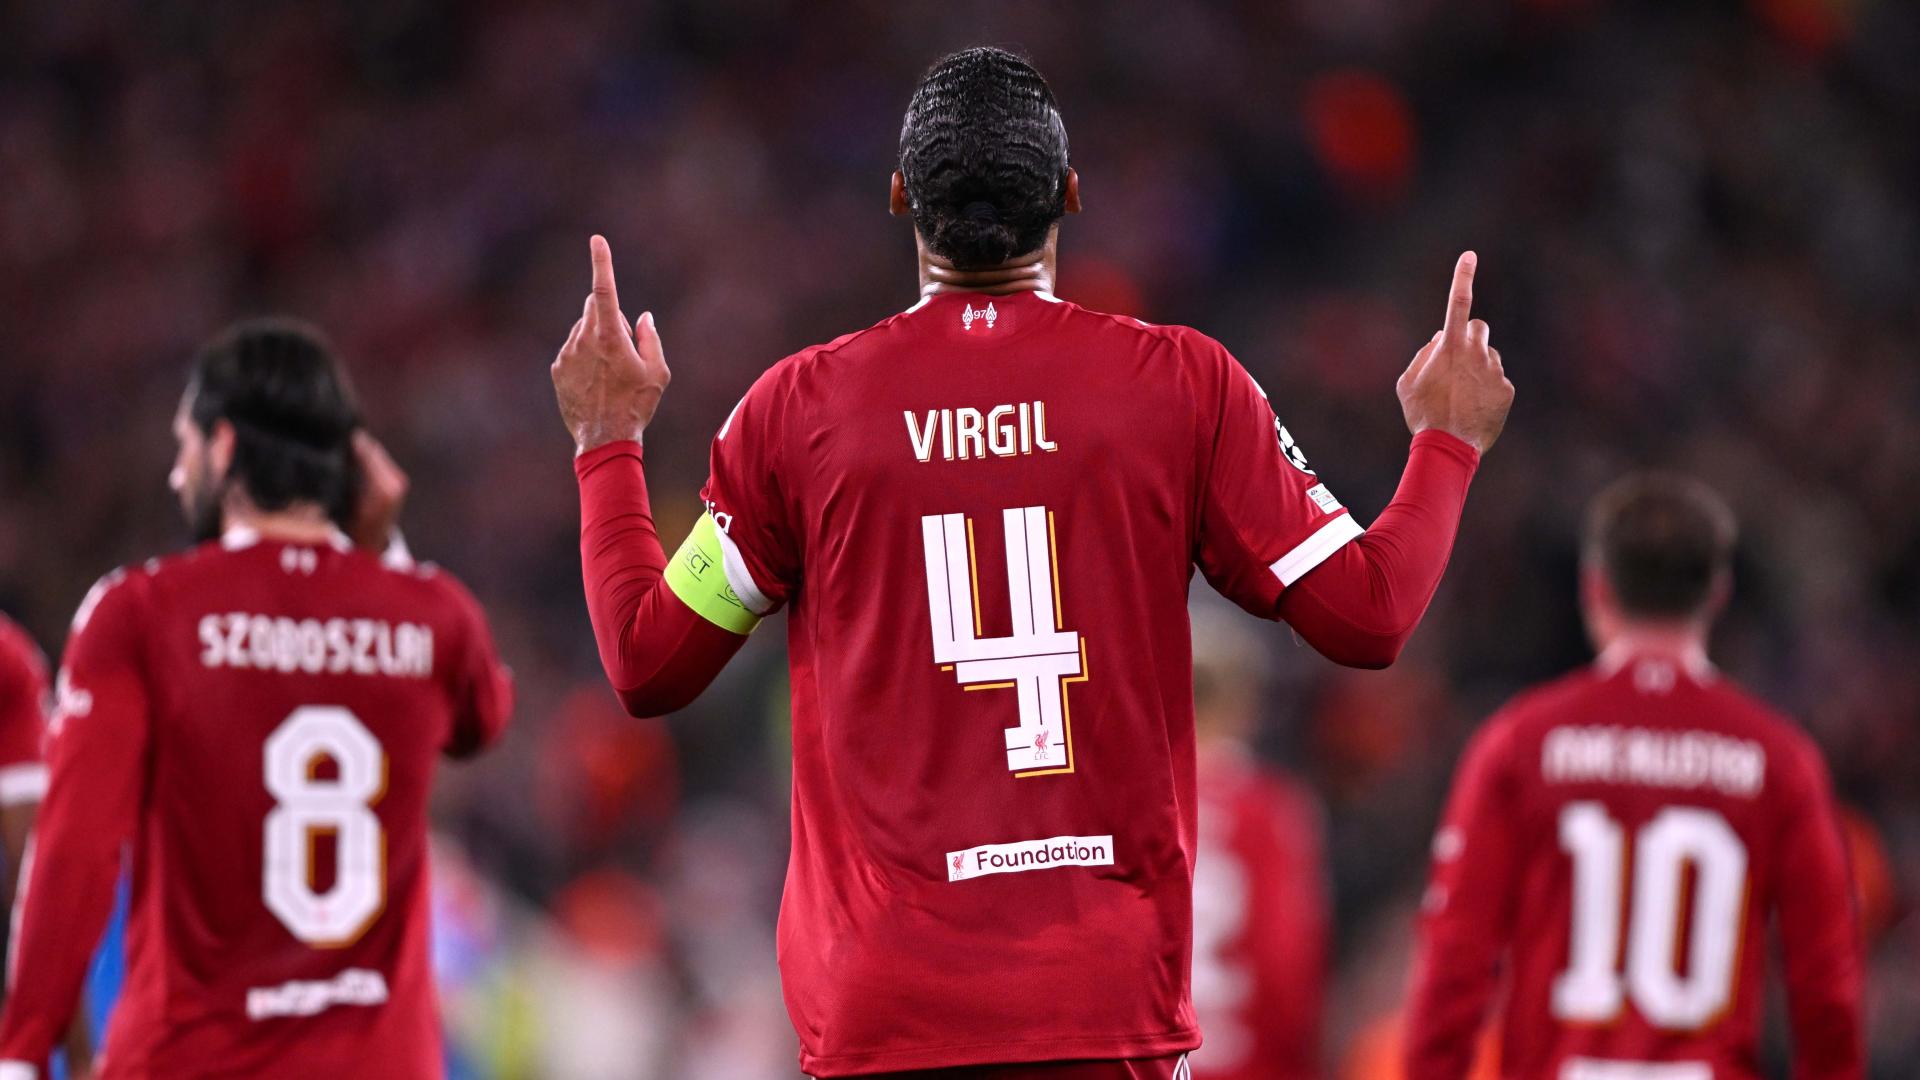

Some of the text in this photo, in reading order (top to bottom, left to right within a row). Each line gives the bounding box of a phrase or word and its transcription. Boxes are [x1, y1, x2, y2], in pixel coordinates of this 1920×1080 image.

[973, 309, 987, 320] 97
[904, 401, 1058, 462] VIRGIL
[921, 505, 1089, 779] 4
[262, 705, 389, 949] 8
[976, 841, 1106, 871] Foundation
[1550, 800, 1752, 1031] 10
